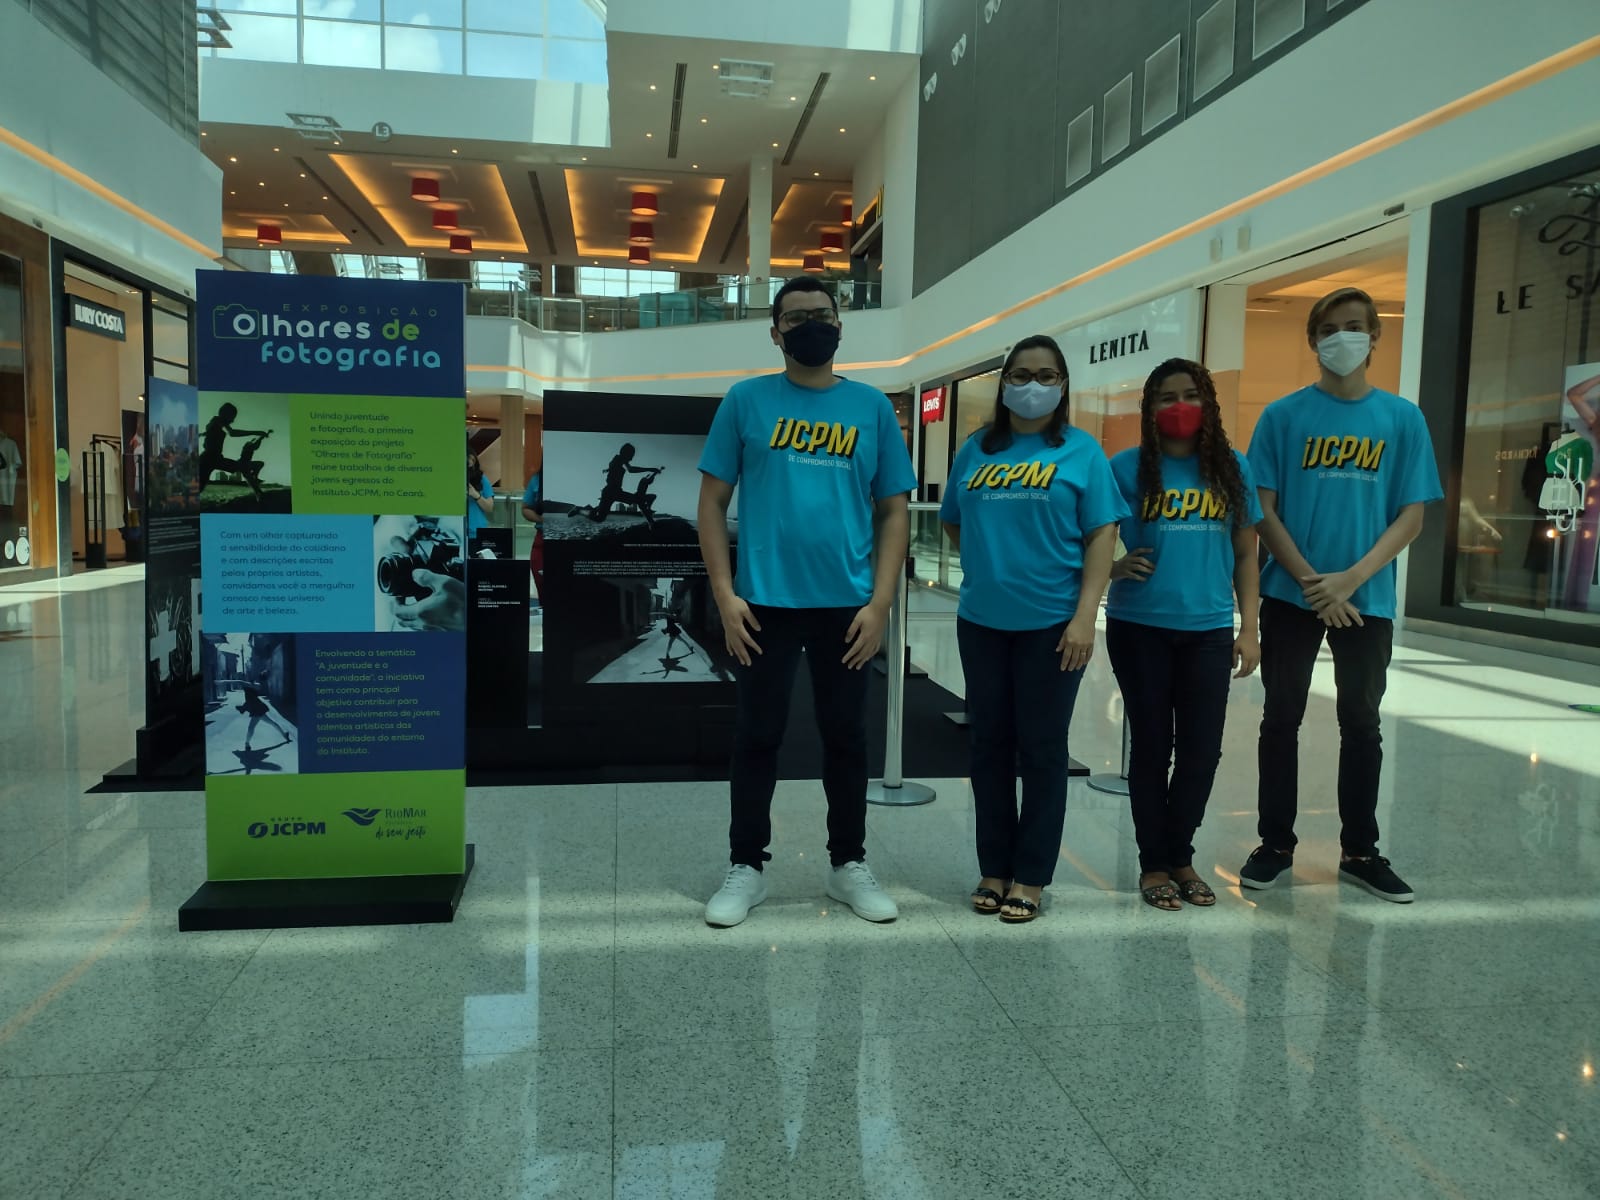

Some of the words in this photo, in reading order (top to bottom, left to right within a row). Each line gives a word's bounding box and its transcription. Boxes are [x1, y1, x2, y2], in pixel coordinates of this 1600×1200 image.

[375, 125, 389, 137] L3
[95, 310, 124, 334] COSTA
[232, 313, 371, 340] Olhares
[382, 319, 420, 341] de
[1089, 329, 1149, 365] LENITA
[261, 341, 441, 372] fotografia
[310, 411, 343, 420] Unindo
[344, 413, 390, 422] juventude
[376, 426, 414, 435] primeira
[310, 438, 356, 447] exposição
[372, 439, 405, 449] projeto
[351, 450, 364, 458] de
[788, 454, 795, 463] DE
[796, 456, 835, 467] COMPROMISSO
[835, 460, 852, 471] SOCIAL
[311, 463, 337, 471] reúne
[340, 463, 382, 471] trabalhos
[396, 464, 433, 472] diversos
[310, 476, 340, 485] jovens
[342, 477, 380, 485] egressos
[382, 476, 394, 484] do
[1030, 493, 1050, 502] SOCIAL
[220, 530, 241, 539] Com
[260, 531, 283, 539] olhar
[285, 531, 338, 540] capturando
[229, 544, 288, 552] sensibilidade
[290, 544, 302, 552] do
[303, 544, 346, 552] cotidiano
[250, 557, 297, 566] descrições
[248, 569, 284, 579] próprios
[309, 582, 355, 591] mergulhar
[222, 607, 235, 615] de
[236, 607, 255, 615] arte
[315, 649, 366, 657] Envolvendo
[376, 648, 416, 657] temática
[327, 662, 373, 671] juventude
[385, 673, 425, 681] iniciativa
[362, 685, 400, 696] principal
[316, 699, 352, 708] objetivo
[353, 698, 395, 706] contribuir
[397, 699, 419, 707] para
[324, 711, 399, 719] desenvolvimento
[412, 710, 440, 719] jovens
[316, 723, 353, 731] talentos
[354, 722, 394, 730] artísticos
[316, 734, 376, 743] comunidades
[270, 822, 326, 836] JCPM
